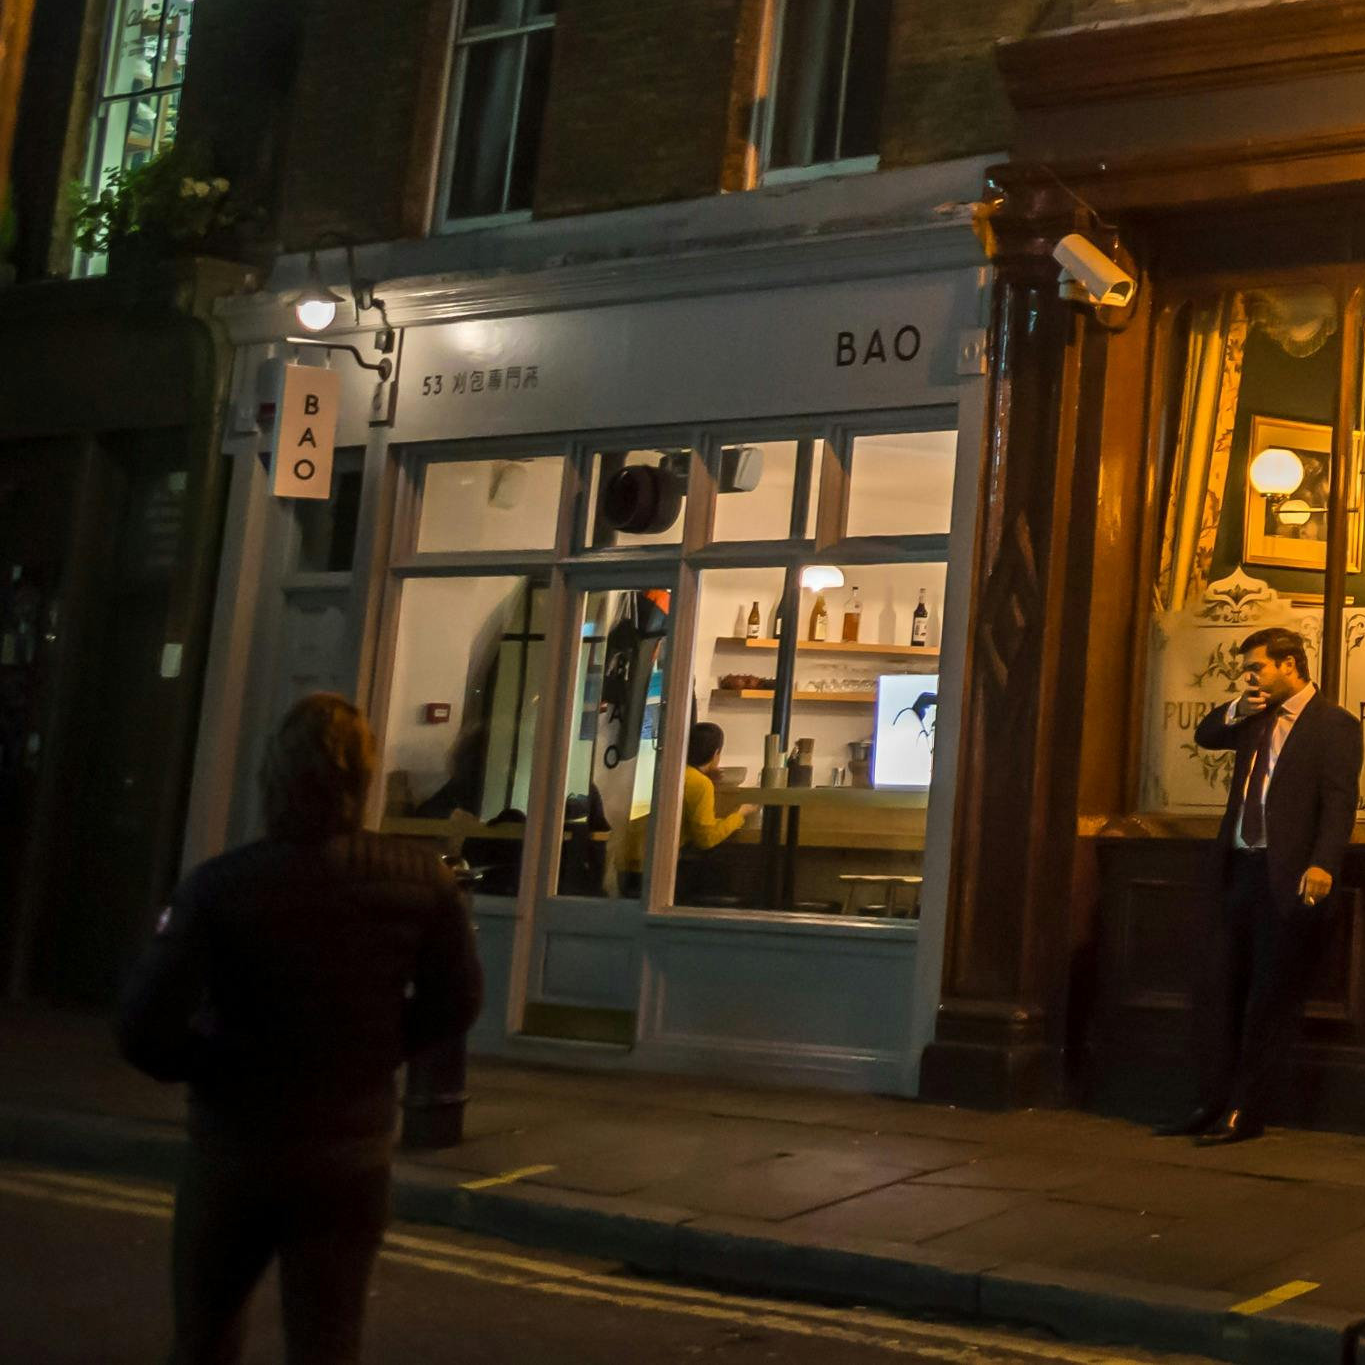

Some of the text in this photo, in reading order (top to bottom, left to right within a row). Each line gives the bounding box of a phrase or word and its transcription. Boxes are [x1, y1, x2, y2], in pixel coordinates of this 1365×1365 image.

[836, 325, 921, 367] BAO
[422, 374, 443, 395] 53
[294, 394, 319, 480] BAO
